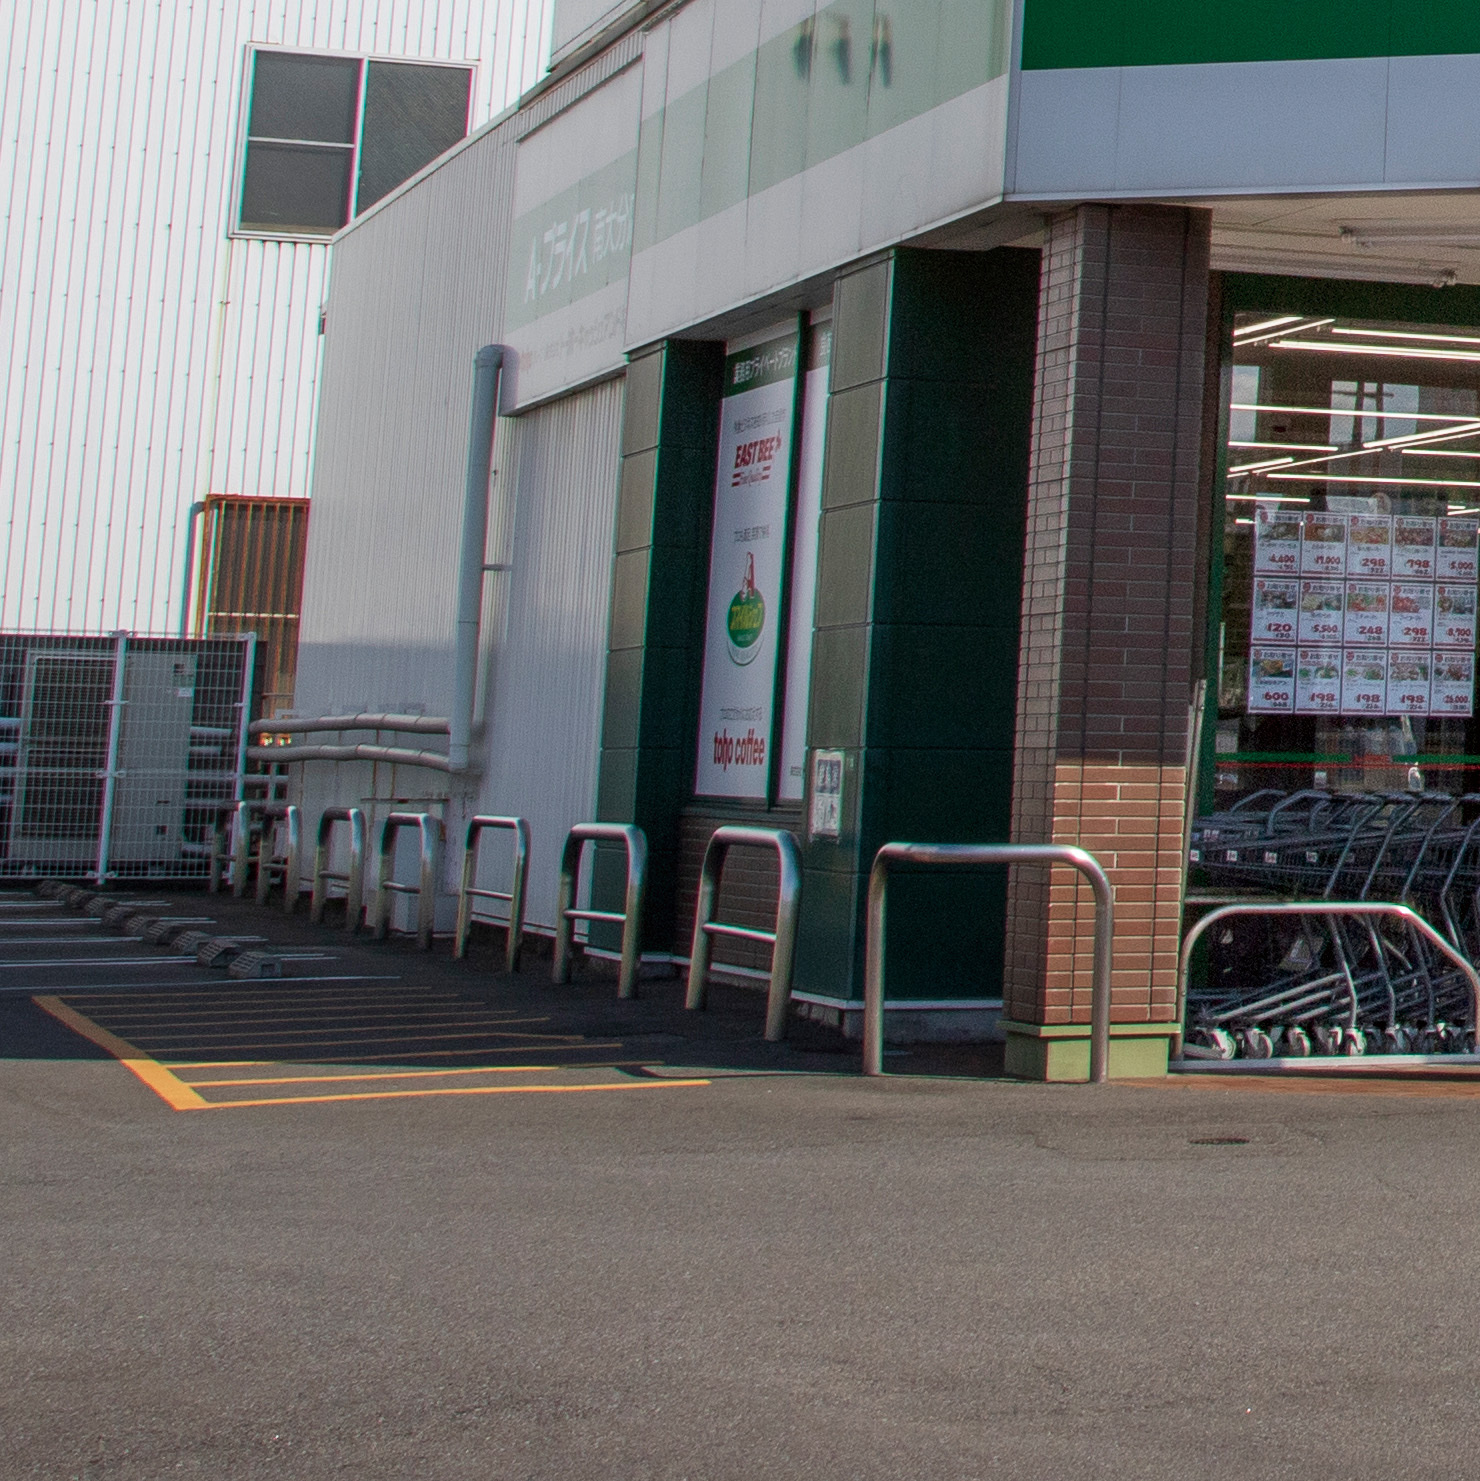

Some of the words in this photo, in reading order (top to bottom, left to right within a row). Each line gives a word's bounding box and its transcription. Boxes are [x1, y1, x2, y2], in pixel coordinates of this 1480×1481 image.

[1267, 622, 1292, 632] 120
[1403, 627, 1428, 636] 298
[1310, 693, 1336, 702] 198
[1356, 694, 1381, 703] 198
[1401, 694, 1425, 703] 198
[714, 728, 733, 772] toho
[734, 727, 765, 767] coffee
